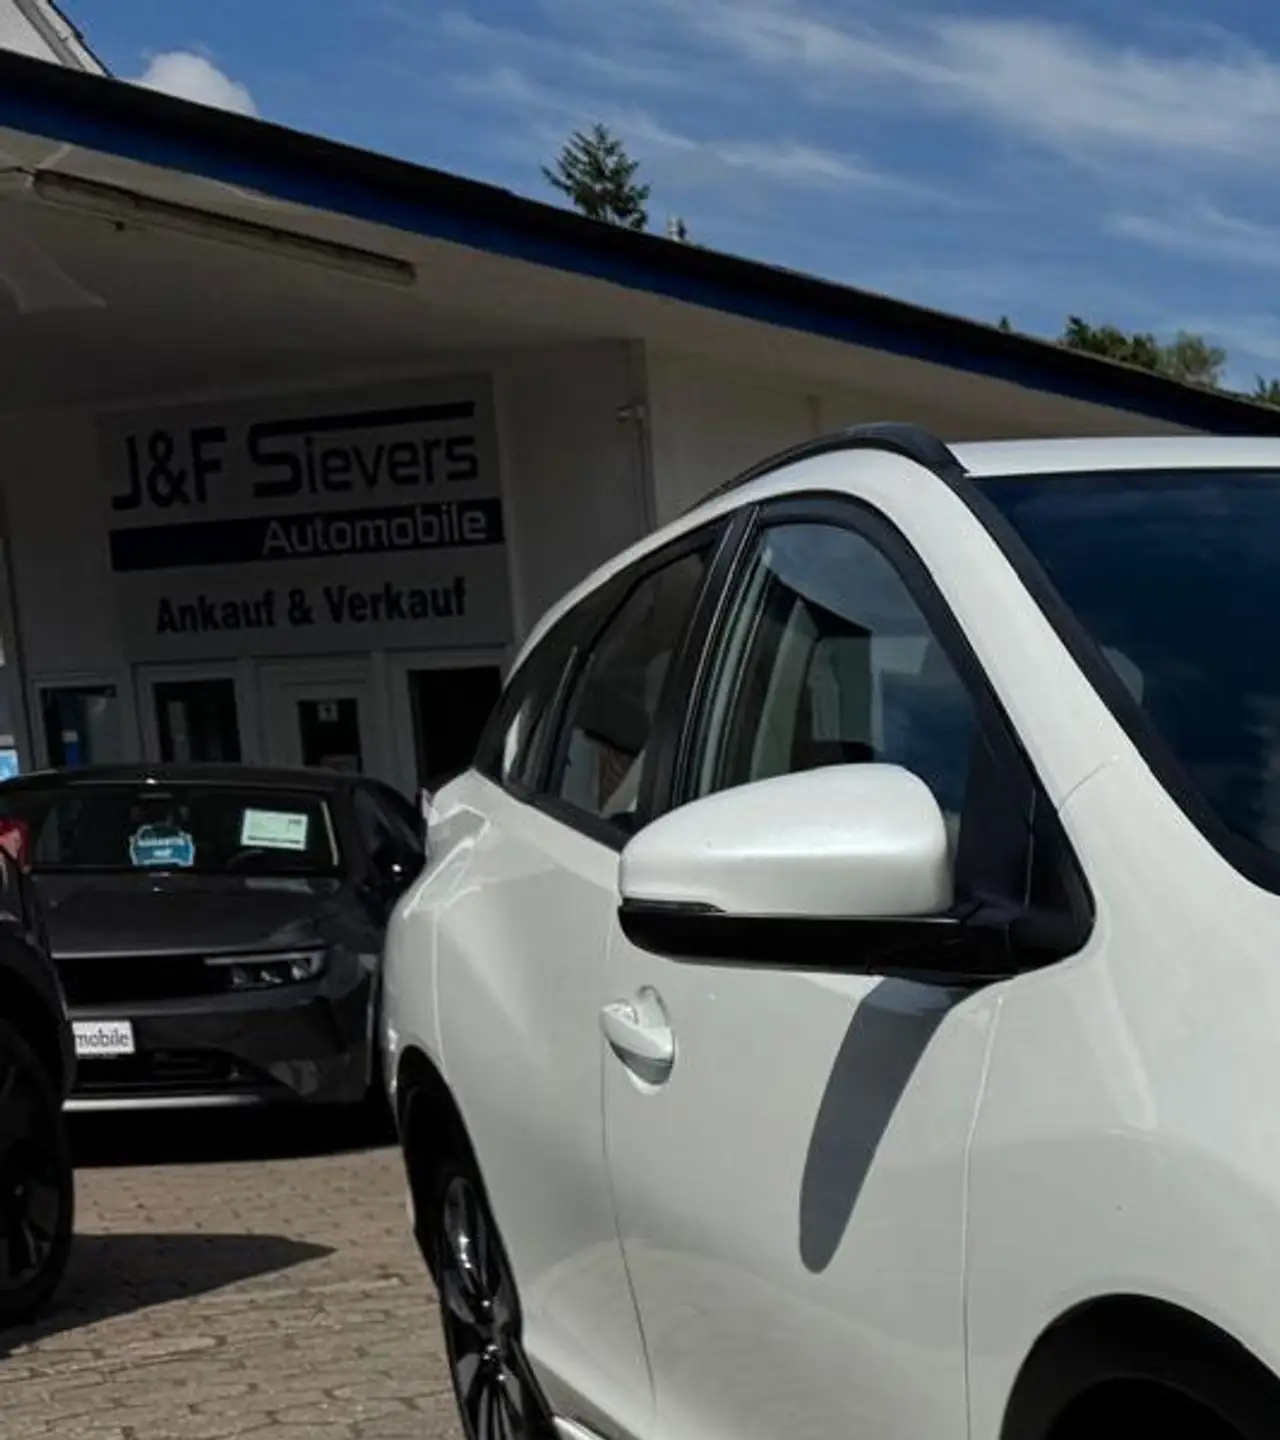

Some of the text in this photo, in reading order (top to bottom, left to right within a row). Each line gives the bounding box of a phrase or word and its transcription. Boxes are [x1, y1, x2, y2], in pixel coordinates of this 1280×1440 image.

[111, 402, 479, 511] J&F Sievers
[262, 504, 488, 556] Automobile
[156, 577, 466, 635] Ankauf & Verkauf
